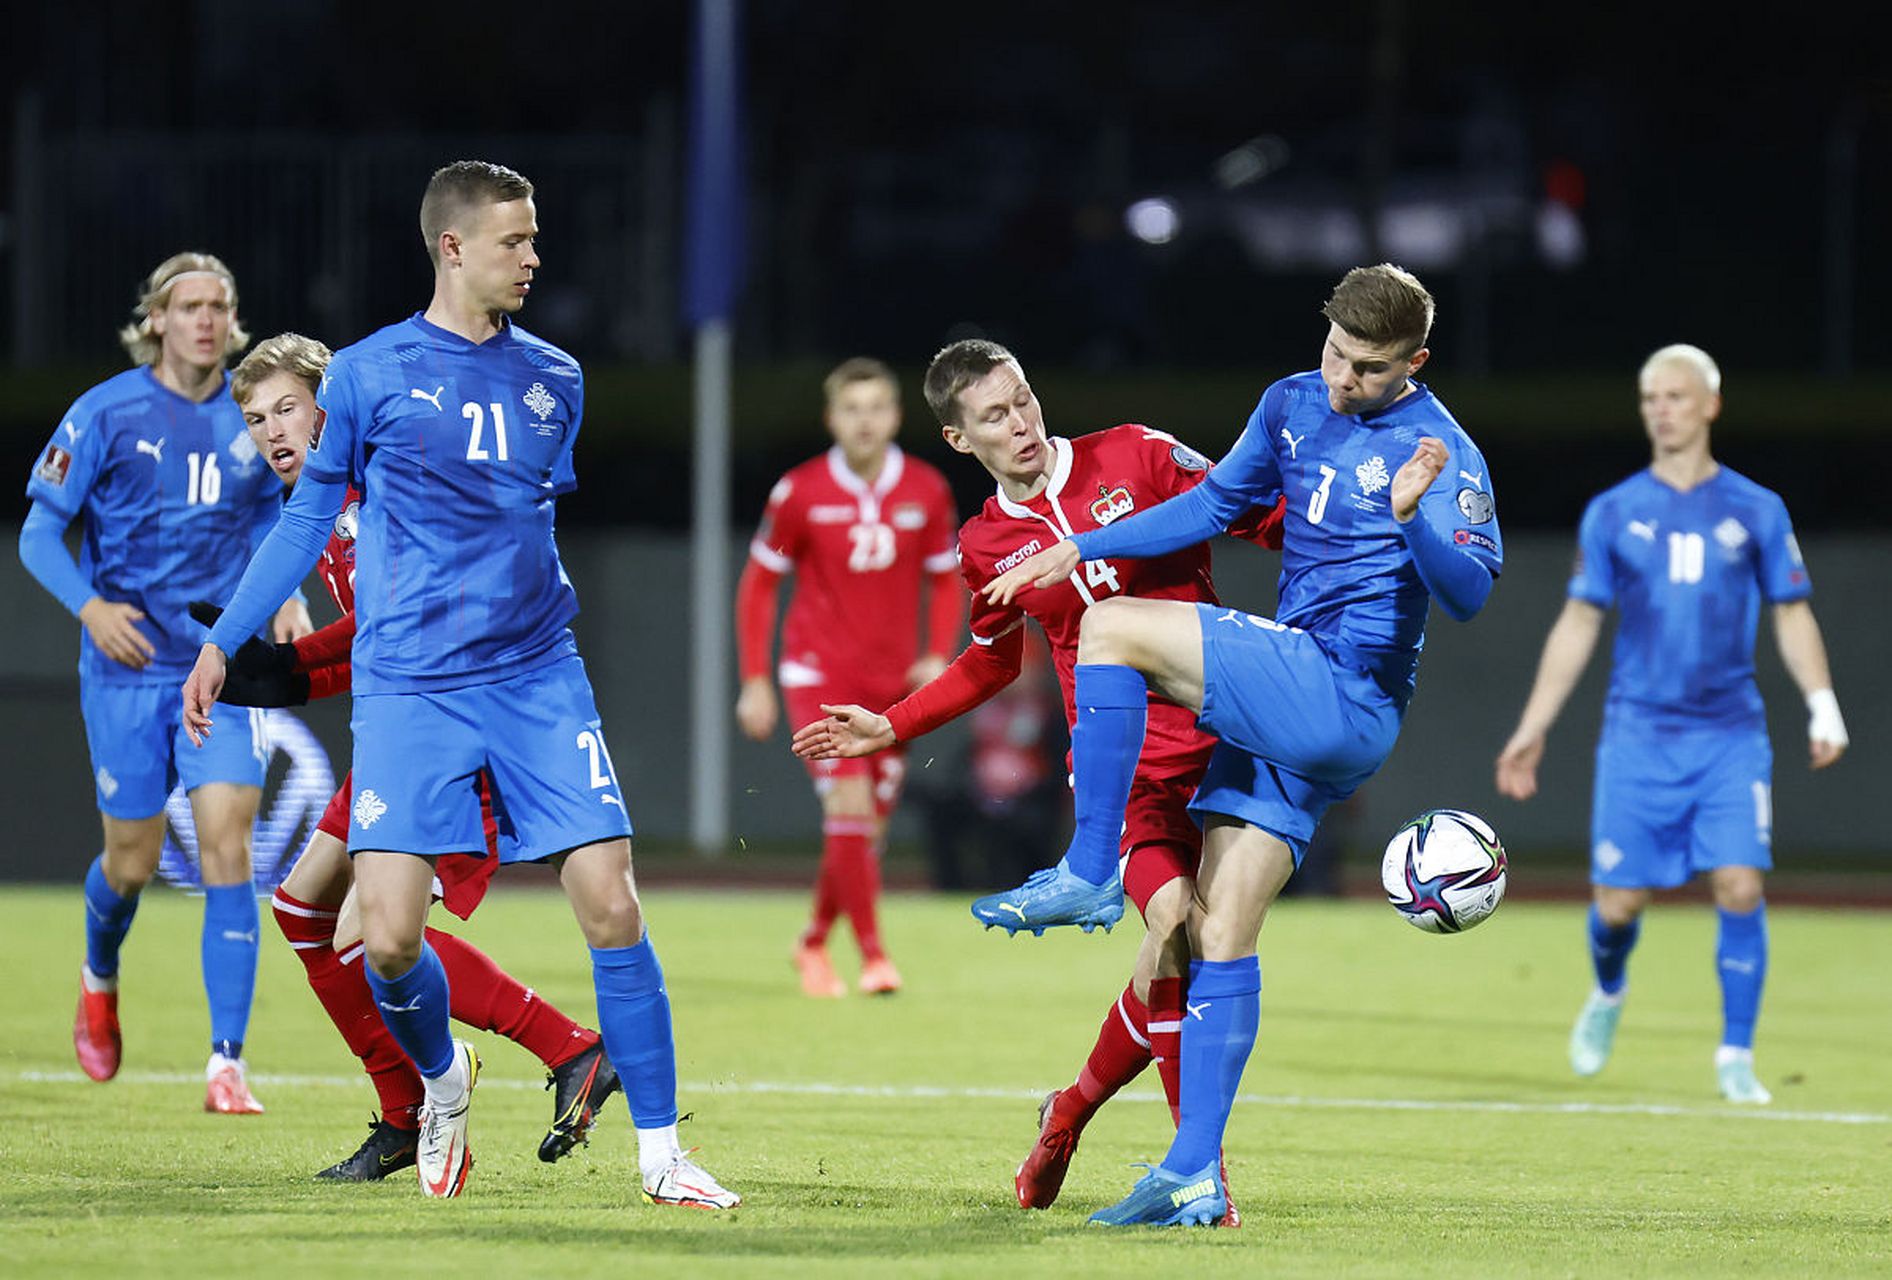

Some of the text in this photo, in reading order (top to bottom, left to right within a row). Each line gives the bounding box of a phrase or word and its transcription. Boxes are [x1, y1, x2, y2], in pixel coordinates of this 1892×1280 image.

[462, 401, 507, 461] 21
[187, 452, 221, 506] 16
[1307, 464, 1336, 525] 3
[848, 522, 897, 572] 23
[994, 539, 1042, 574] macron
[1668, 532, 1704, 584] 10
[1070, 558, 1120, 606] 14
[576, 729, 618, 789] 21
[1170, 1178, 1217, 1208] PUMA
